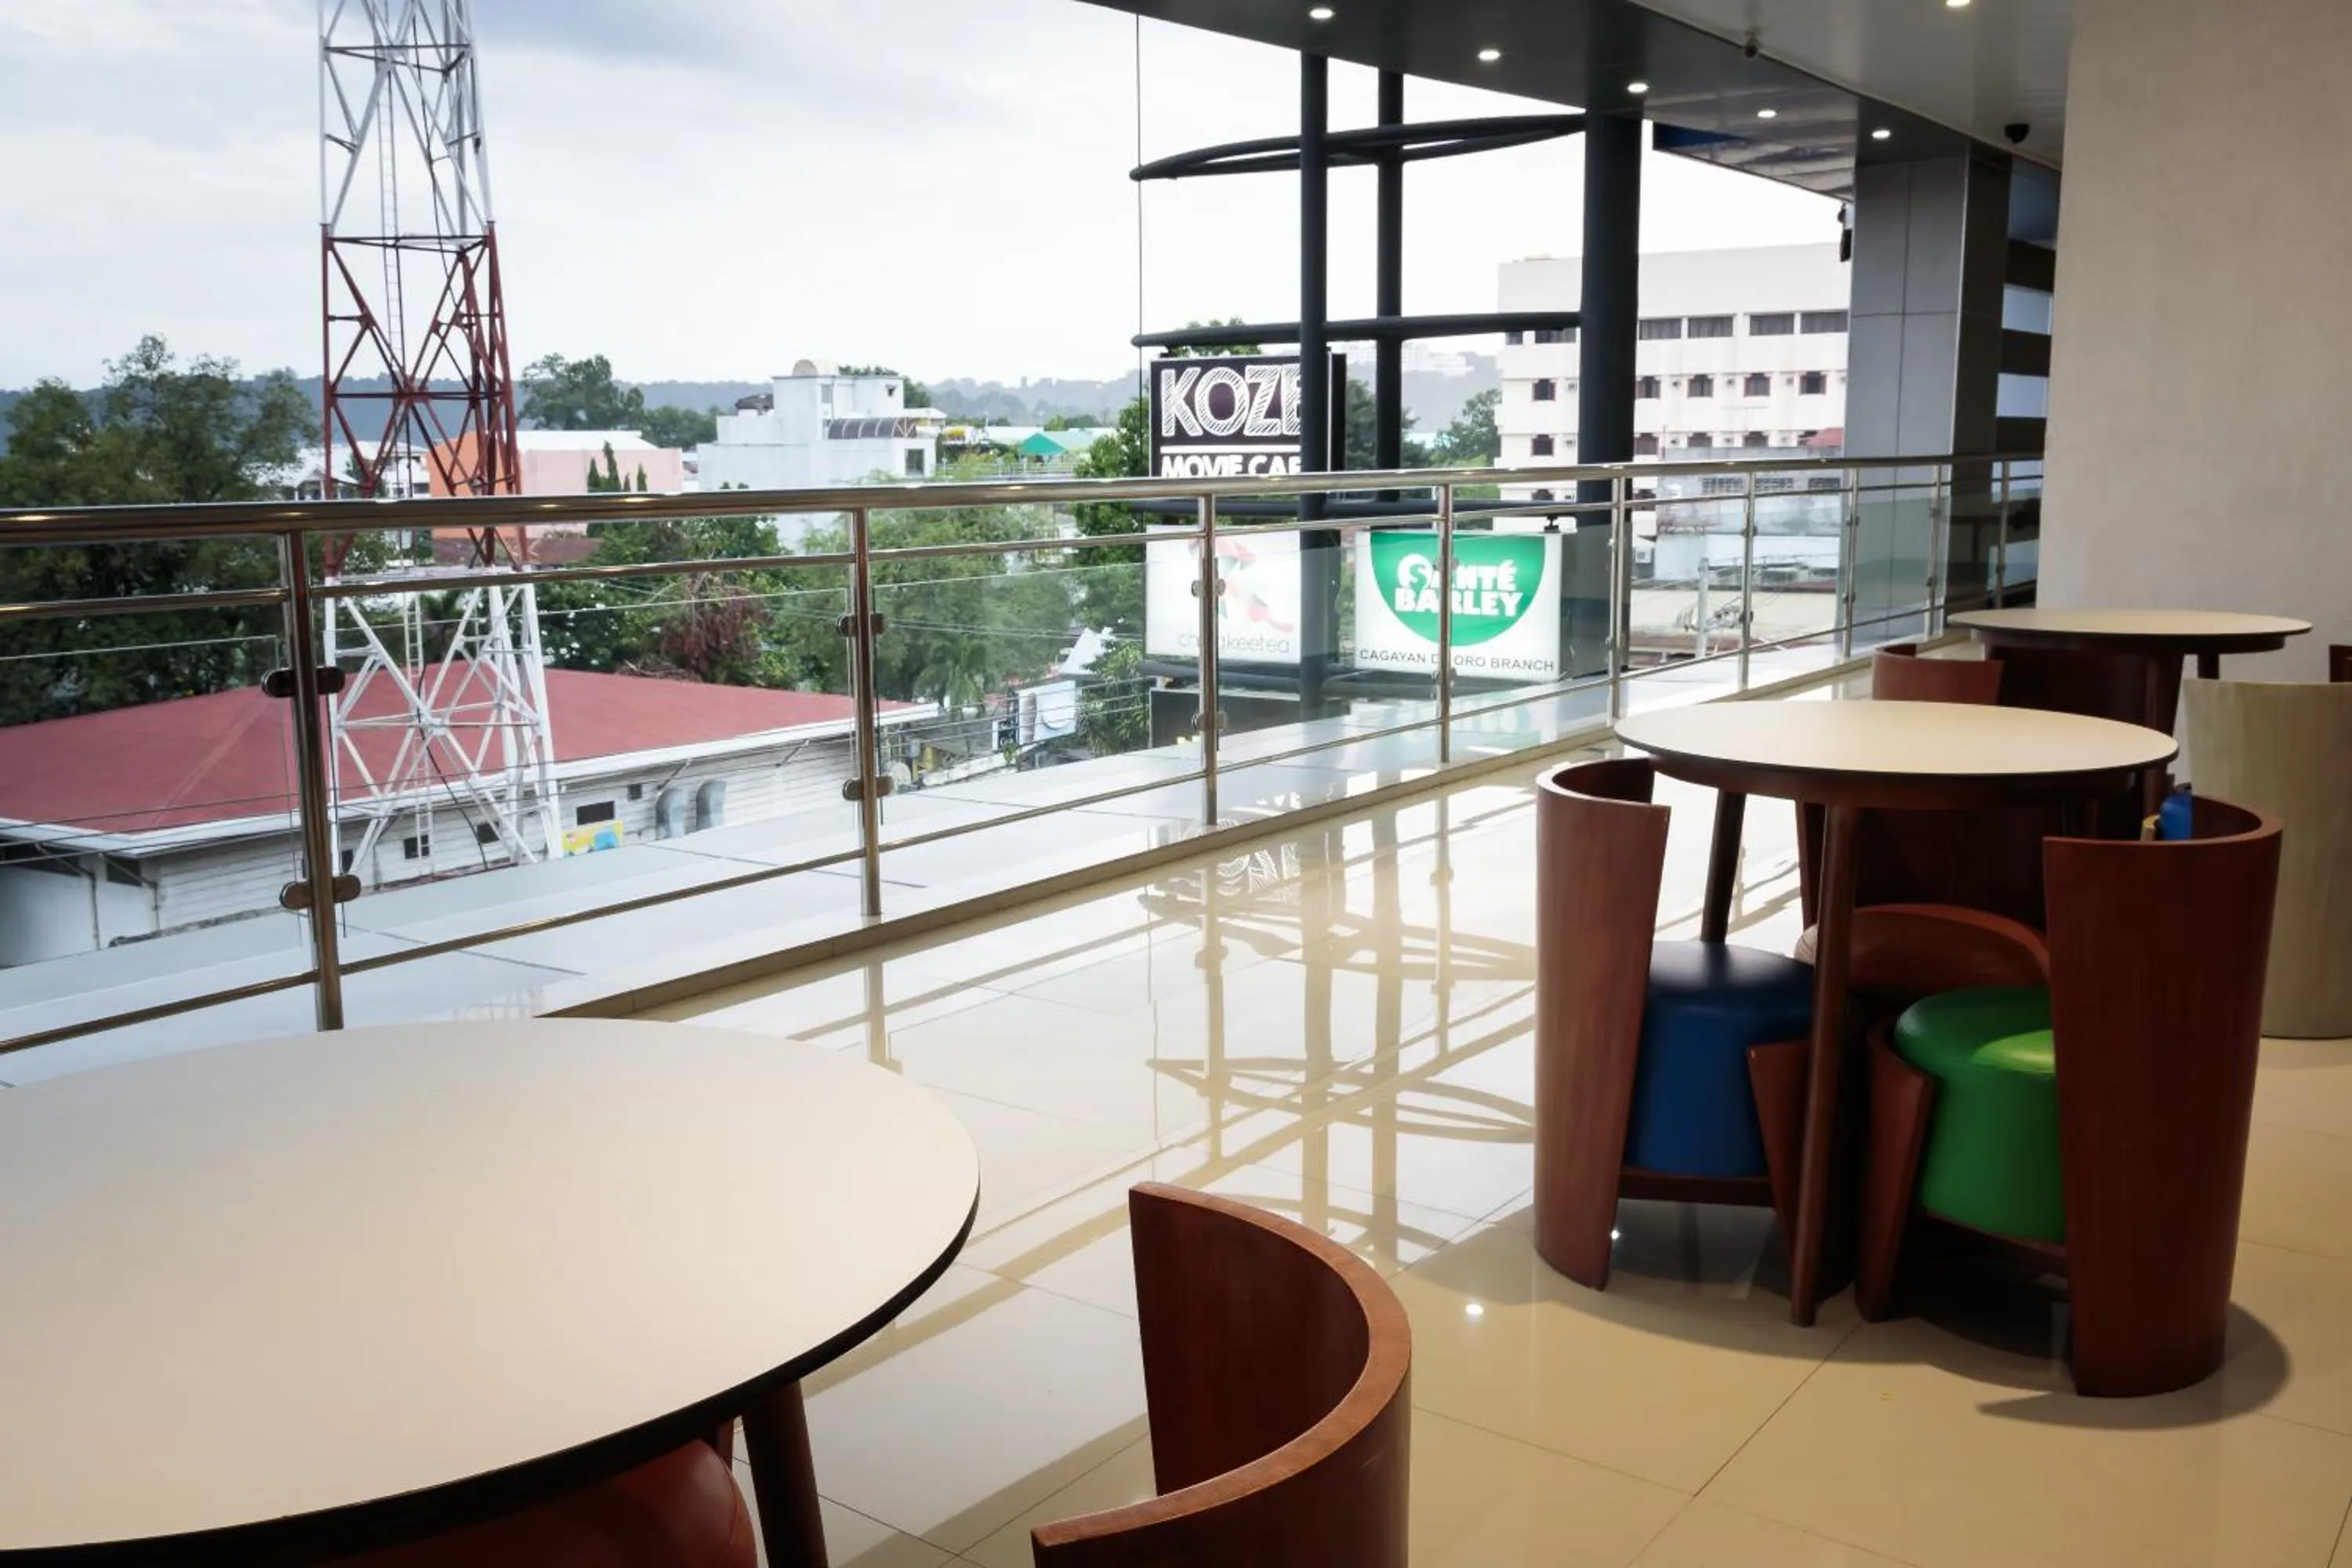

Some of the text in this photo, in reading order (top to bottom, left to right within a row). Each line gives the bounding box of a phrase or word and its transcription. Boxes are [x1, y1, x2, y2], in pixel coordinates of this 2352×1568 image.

[1161, 363, 1301, 437] KOZE
[1161, 454, 1301, 477] MOVIE CAF
[1359, 648, 1426, 664] CAGAYAN
[1454, 654, 1486, 667] ORO
[1490, 657, 1554, 672] BRANCH
